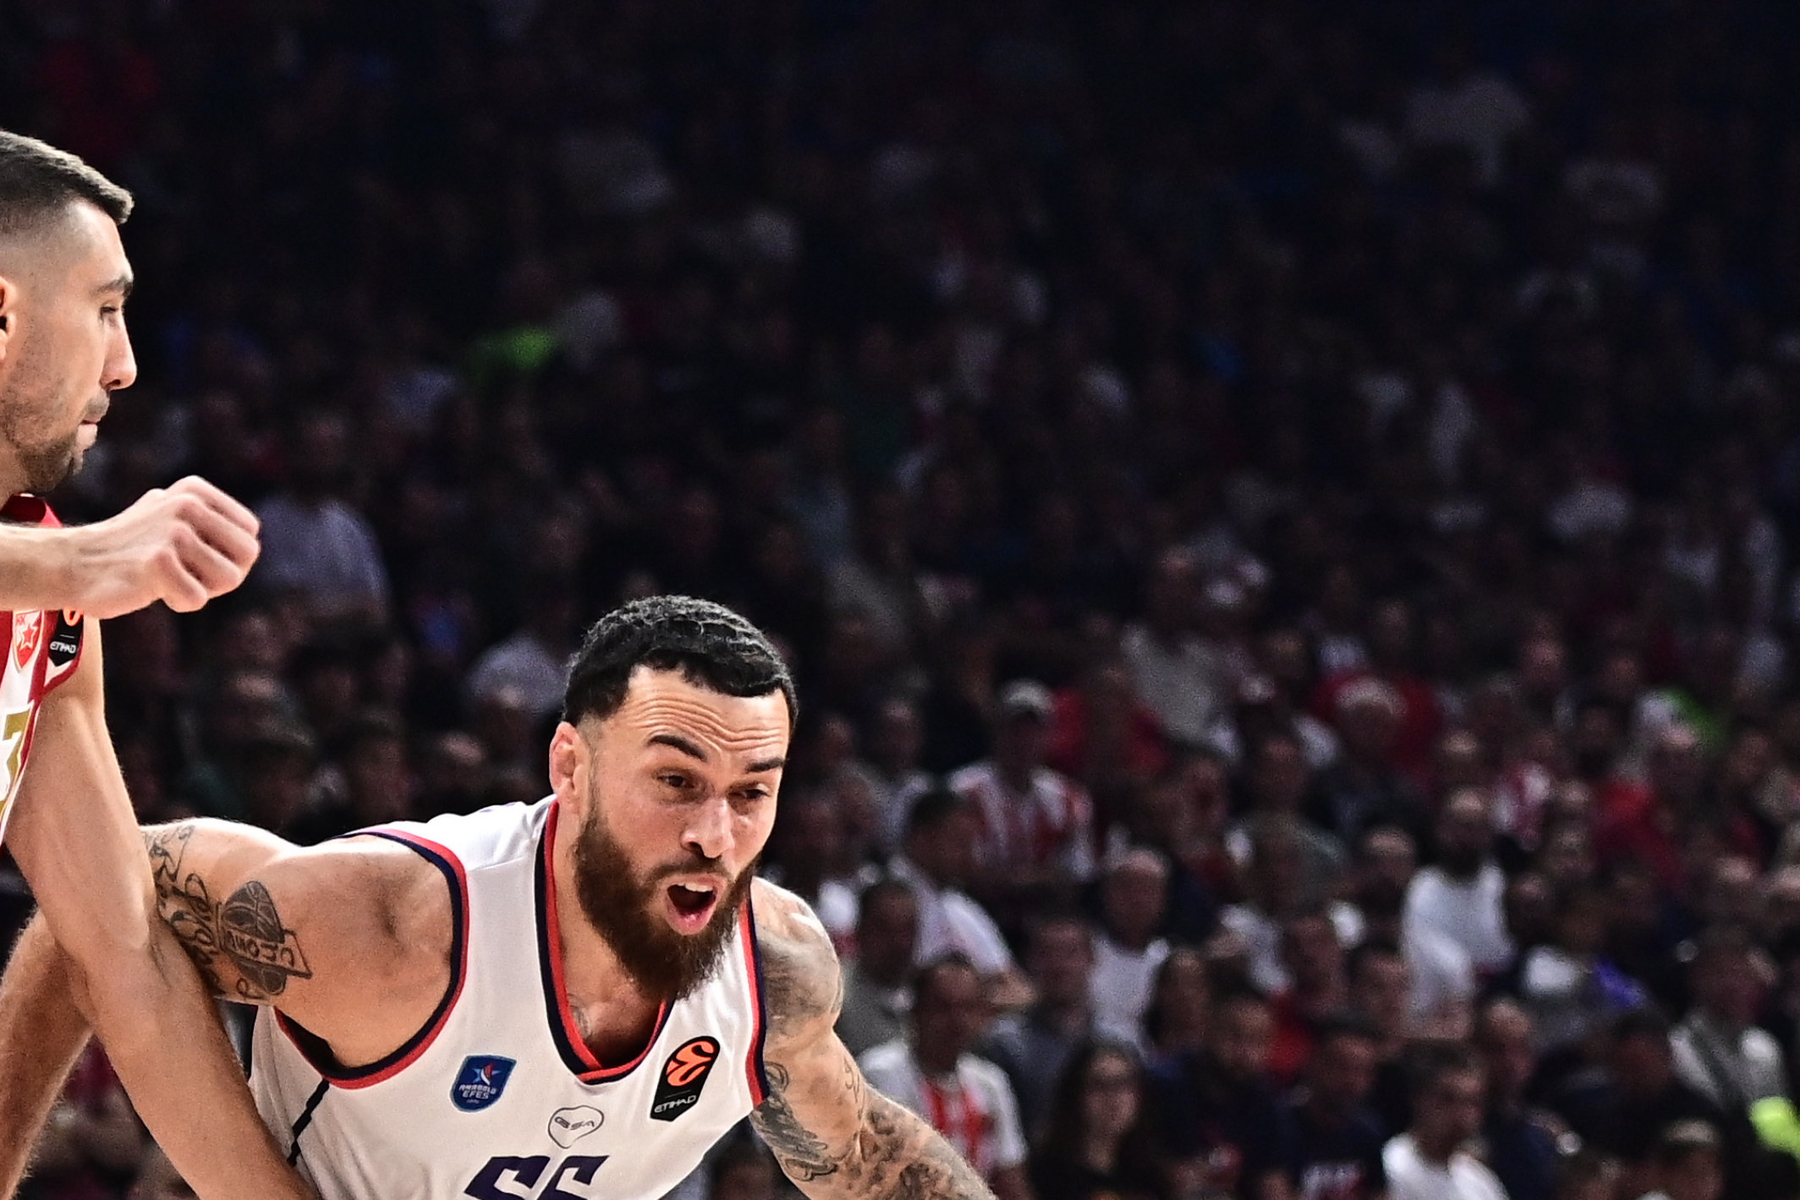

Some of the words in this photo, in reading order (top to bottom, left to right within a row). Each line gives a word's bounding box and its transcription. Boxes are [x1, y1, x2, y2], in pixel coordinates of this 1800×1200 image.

[50, 641, 77, 654] ETIHAD
[459, 1084, 497, 1095] ANADOLU
[462, 1090, 490, 1100] EFES
[653, 1094, 698, 1114] ETIHAD
